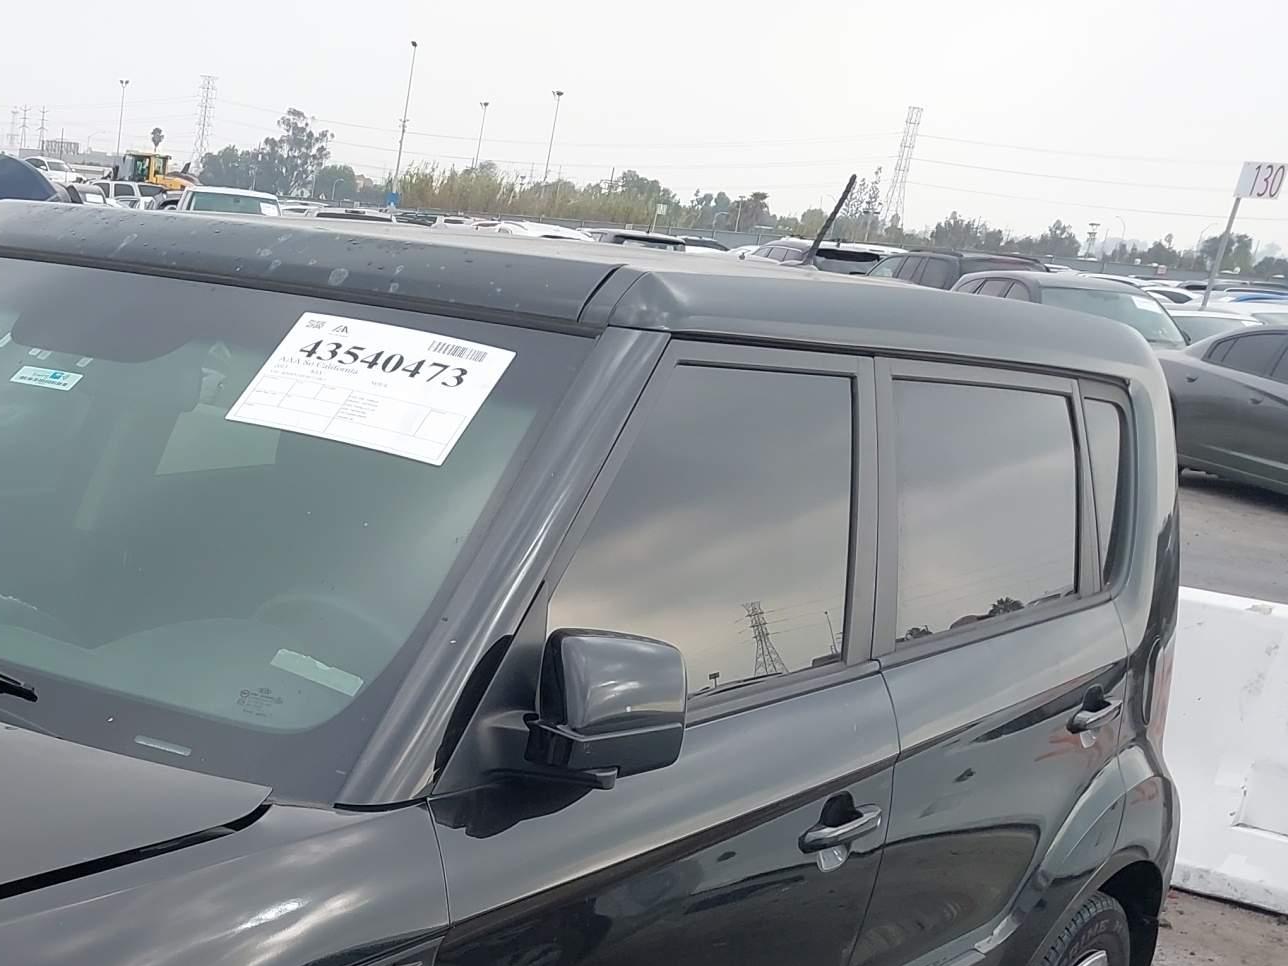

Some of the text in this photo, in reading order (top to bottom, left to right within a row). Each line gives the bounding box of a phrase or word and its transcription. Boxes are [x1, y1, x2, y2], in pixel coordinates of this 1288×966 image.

[1249, 164, 1285, 198] 130
[299, 340, 468, 388] 43540473
[317, 360, 359, 376] California
